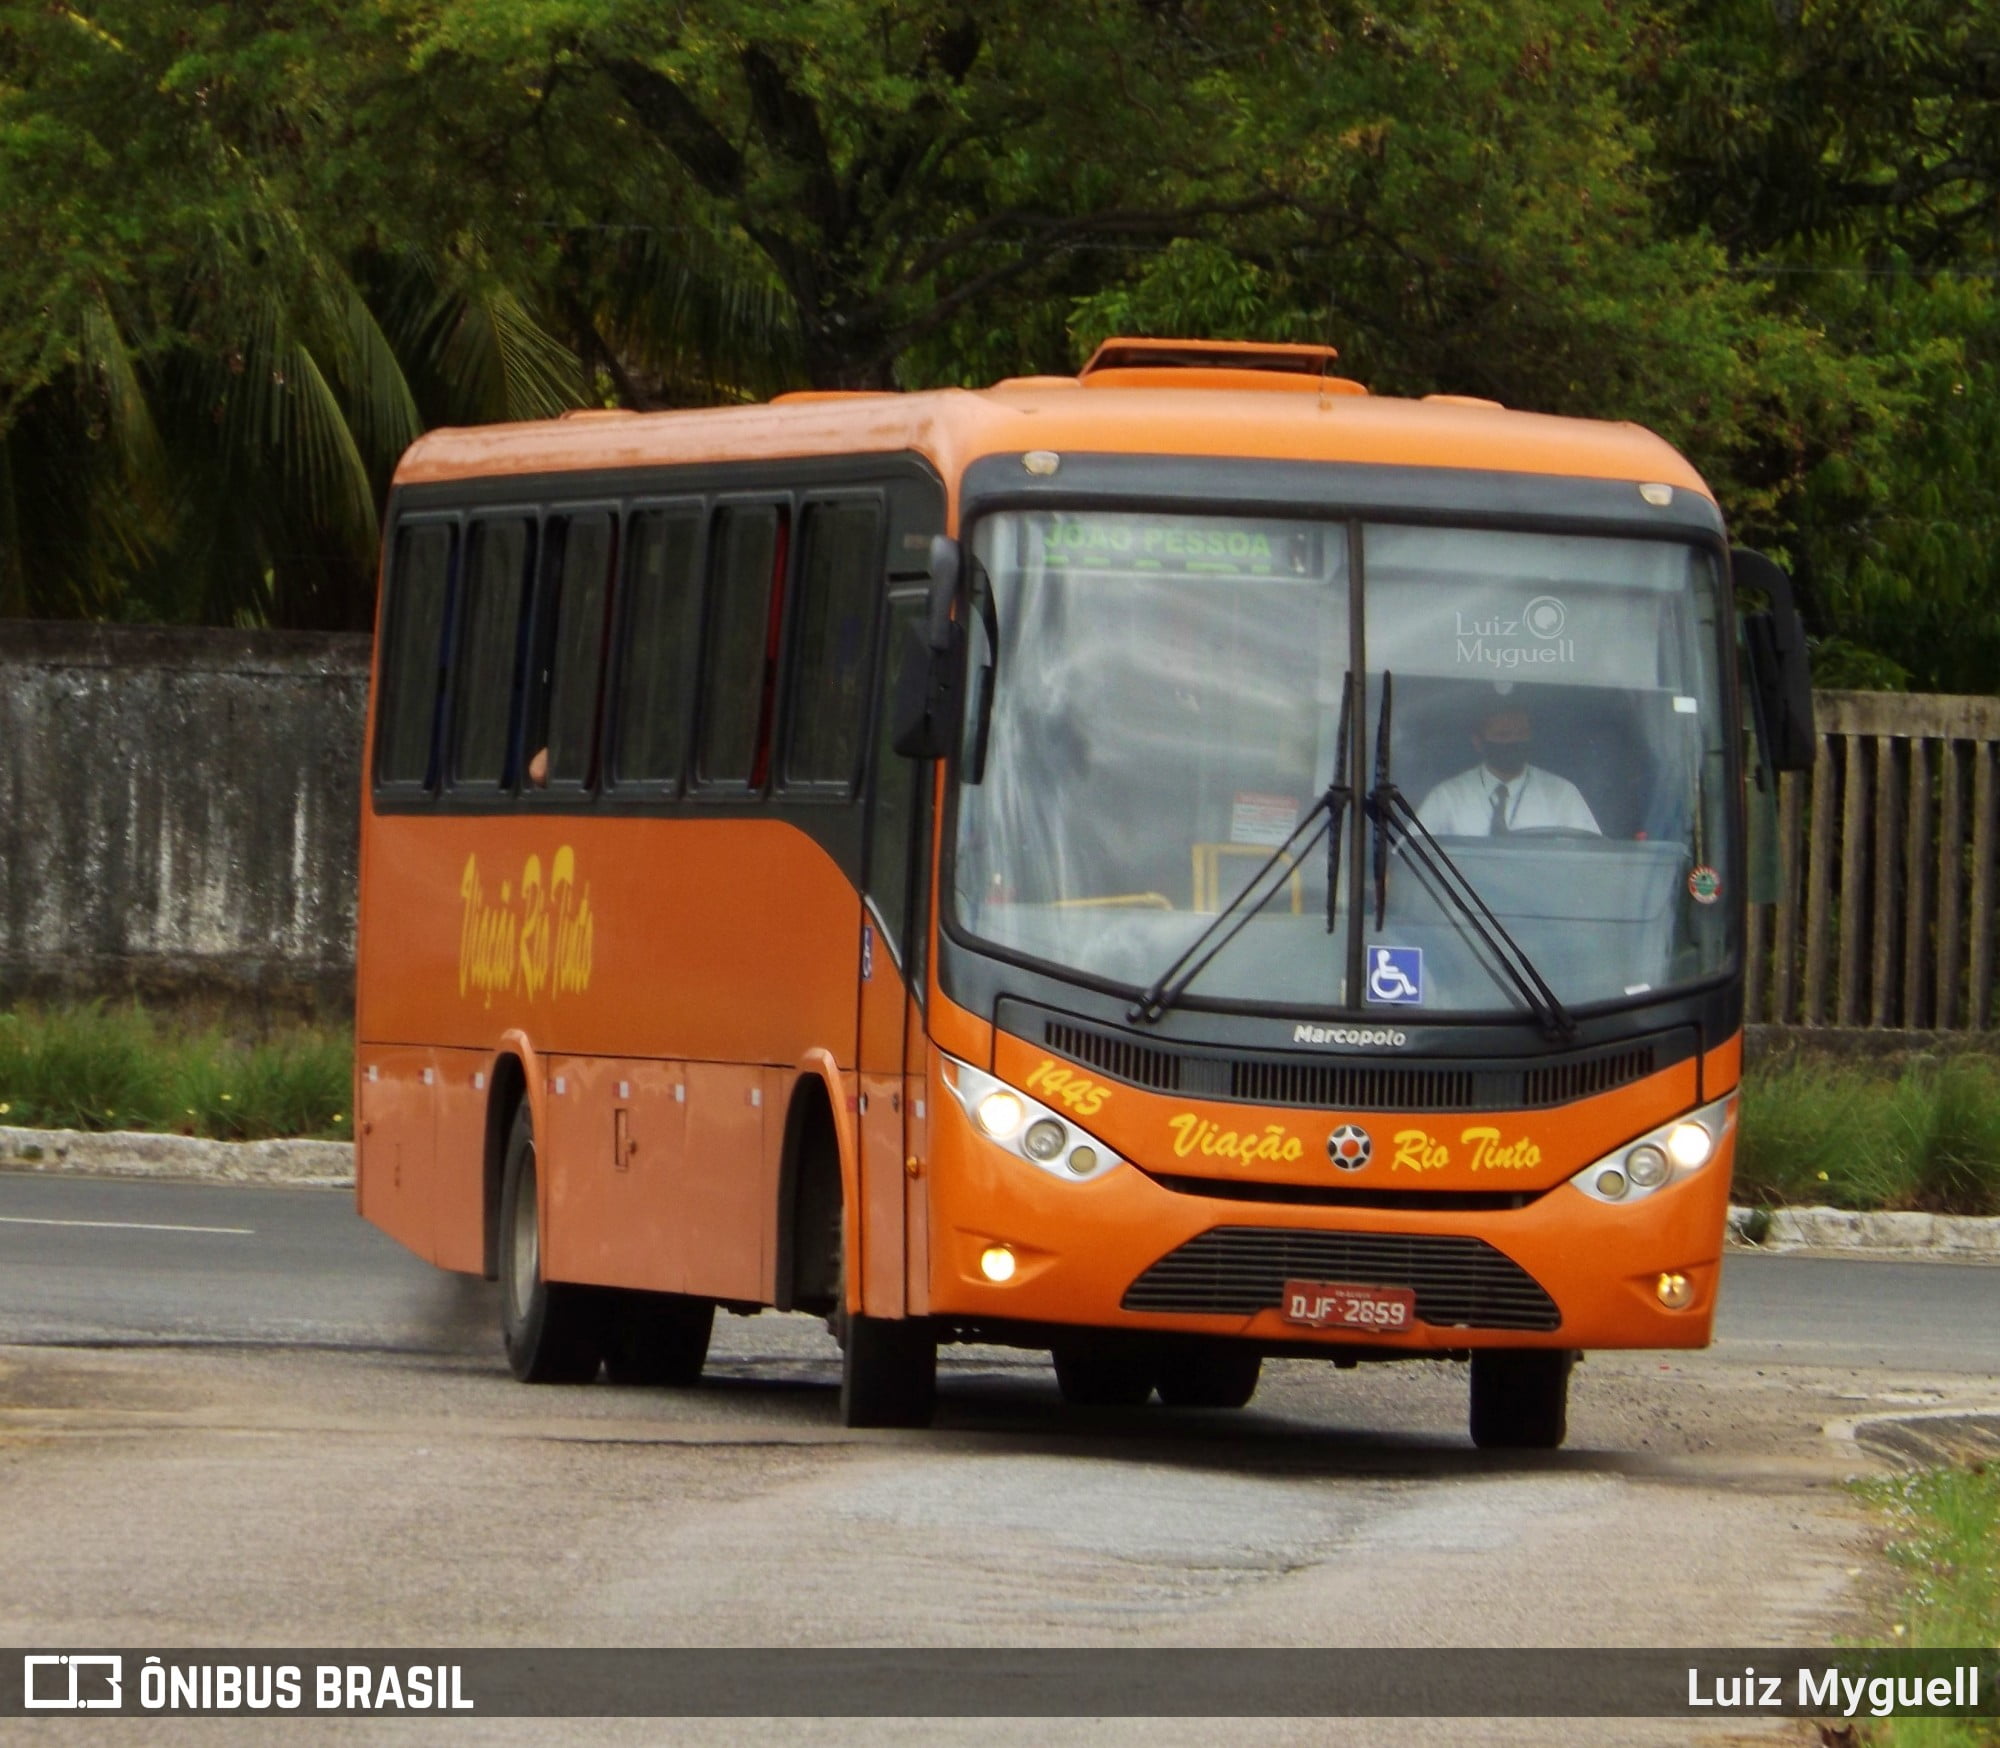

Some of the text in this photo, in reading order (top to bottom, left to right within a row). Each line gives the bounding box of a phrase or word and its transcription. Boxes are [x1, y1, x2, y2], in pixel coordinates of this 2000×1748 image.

[1143, 527, 1271, 558] PESSOA
[1293, 1024, 1406, 1047] Marcopolo
[1025, 1059, 1112, 1116] 1445
[1169, 1112, 1542, 1172] Viação Rio Tinto
